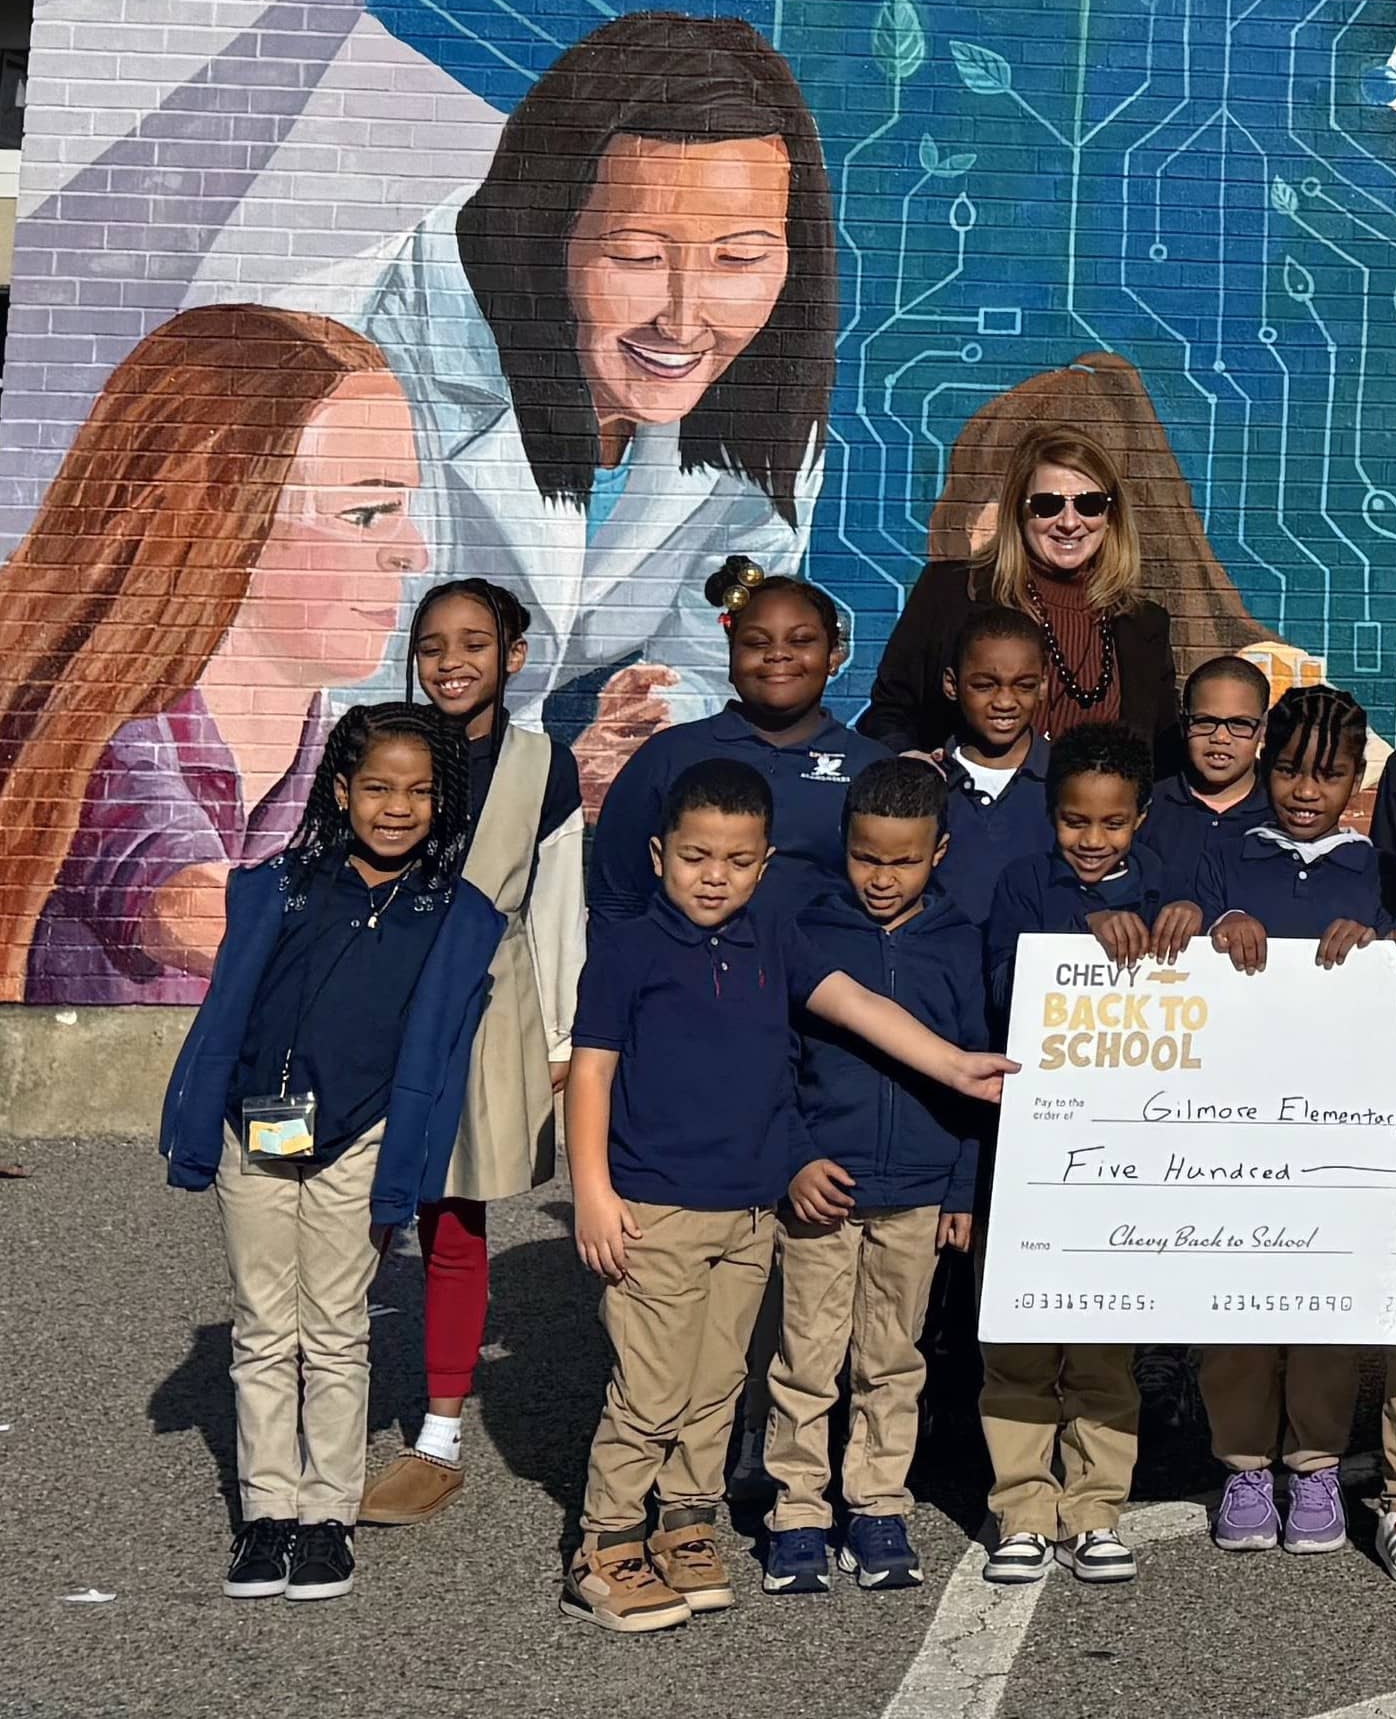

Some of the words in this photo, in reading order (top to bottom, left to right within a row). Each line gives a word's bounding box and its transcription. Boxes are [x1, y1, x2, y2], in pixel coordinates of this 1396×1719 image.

[1055, 963, 1141, 988] CHEVY
[1043, 991, 1152, 1031] BACK
[1160, 994, 1209, 1031] TO
[1038, 1030, 1202, 1071] SCHOOL
[1032, 1110, 1061, 1121] order
[1034, 1096, 1053, 1109] Pay
[1055, 1098, 1067, 1108] to
[1068, 1097, 1085, 1108] the
[1142, 1090, 1259, 1122] Gilmore
[1062, 1145, 1140, 1185] Five
[1163, 1152, 1292, 1183] Hundred
[1109, 1223, 1169, 1255] Chevy
[1174, 1224, 1225, 1248] Back
[1227, 1234, 1245, 1248] to
[1250, 1224, 1320, 1249] School
[1210, 1294, 1354, 1313] 1234567890
